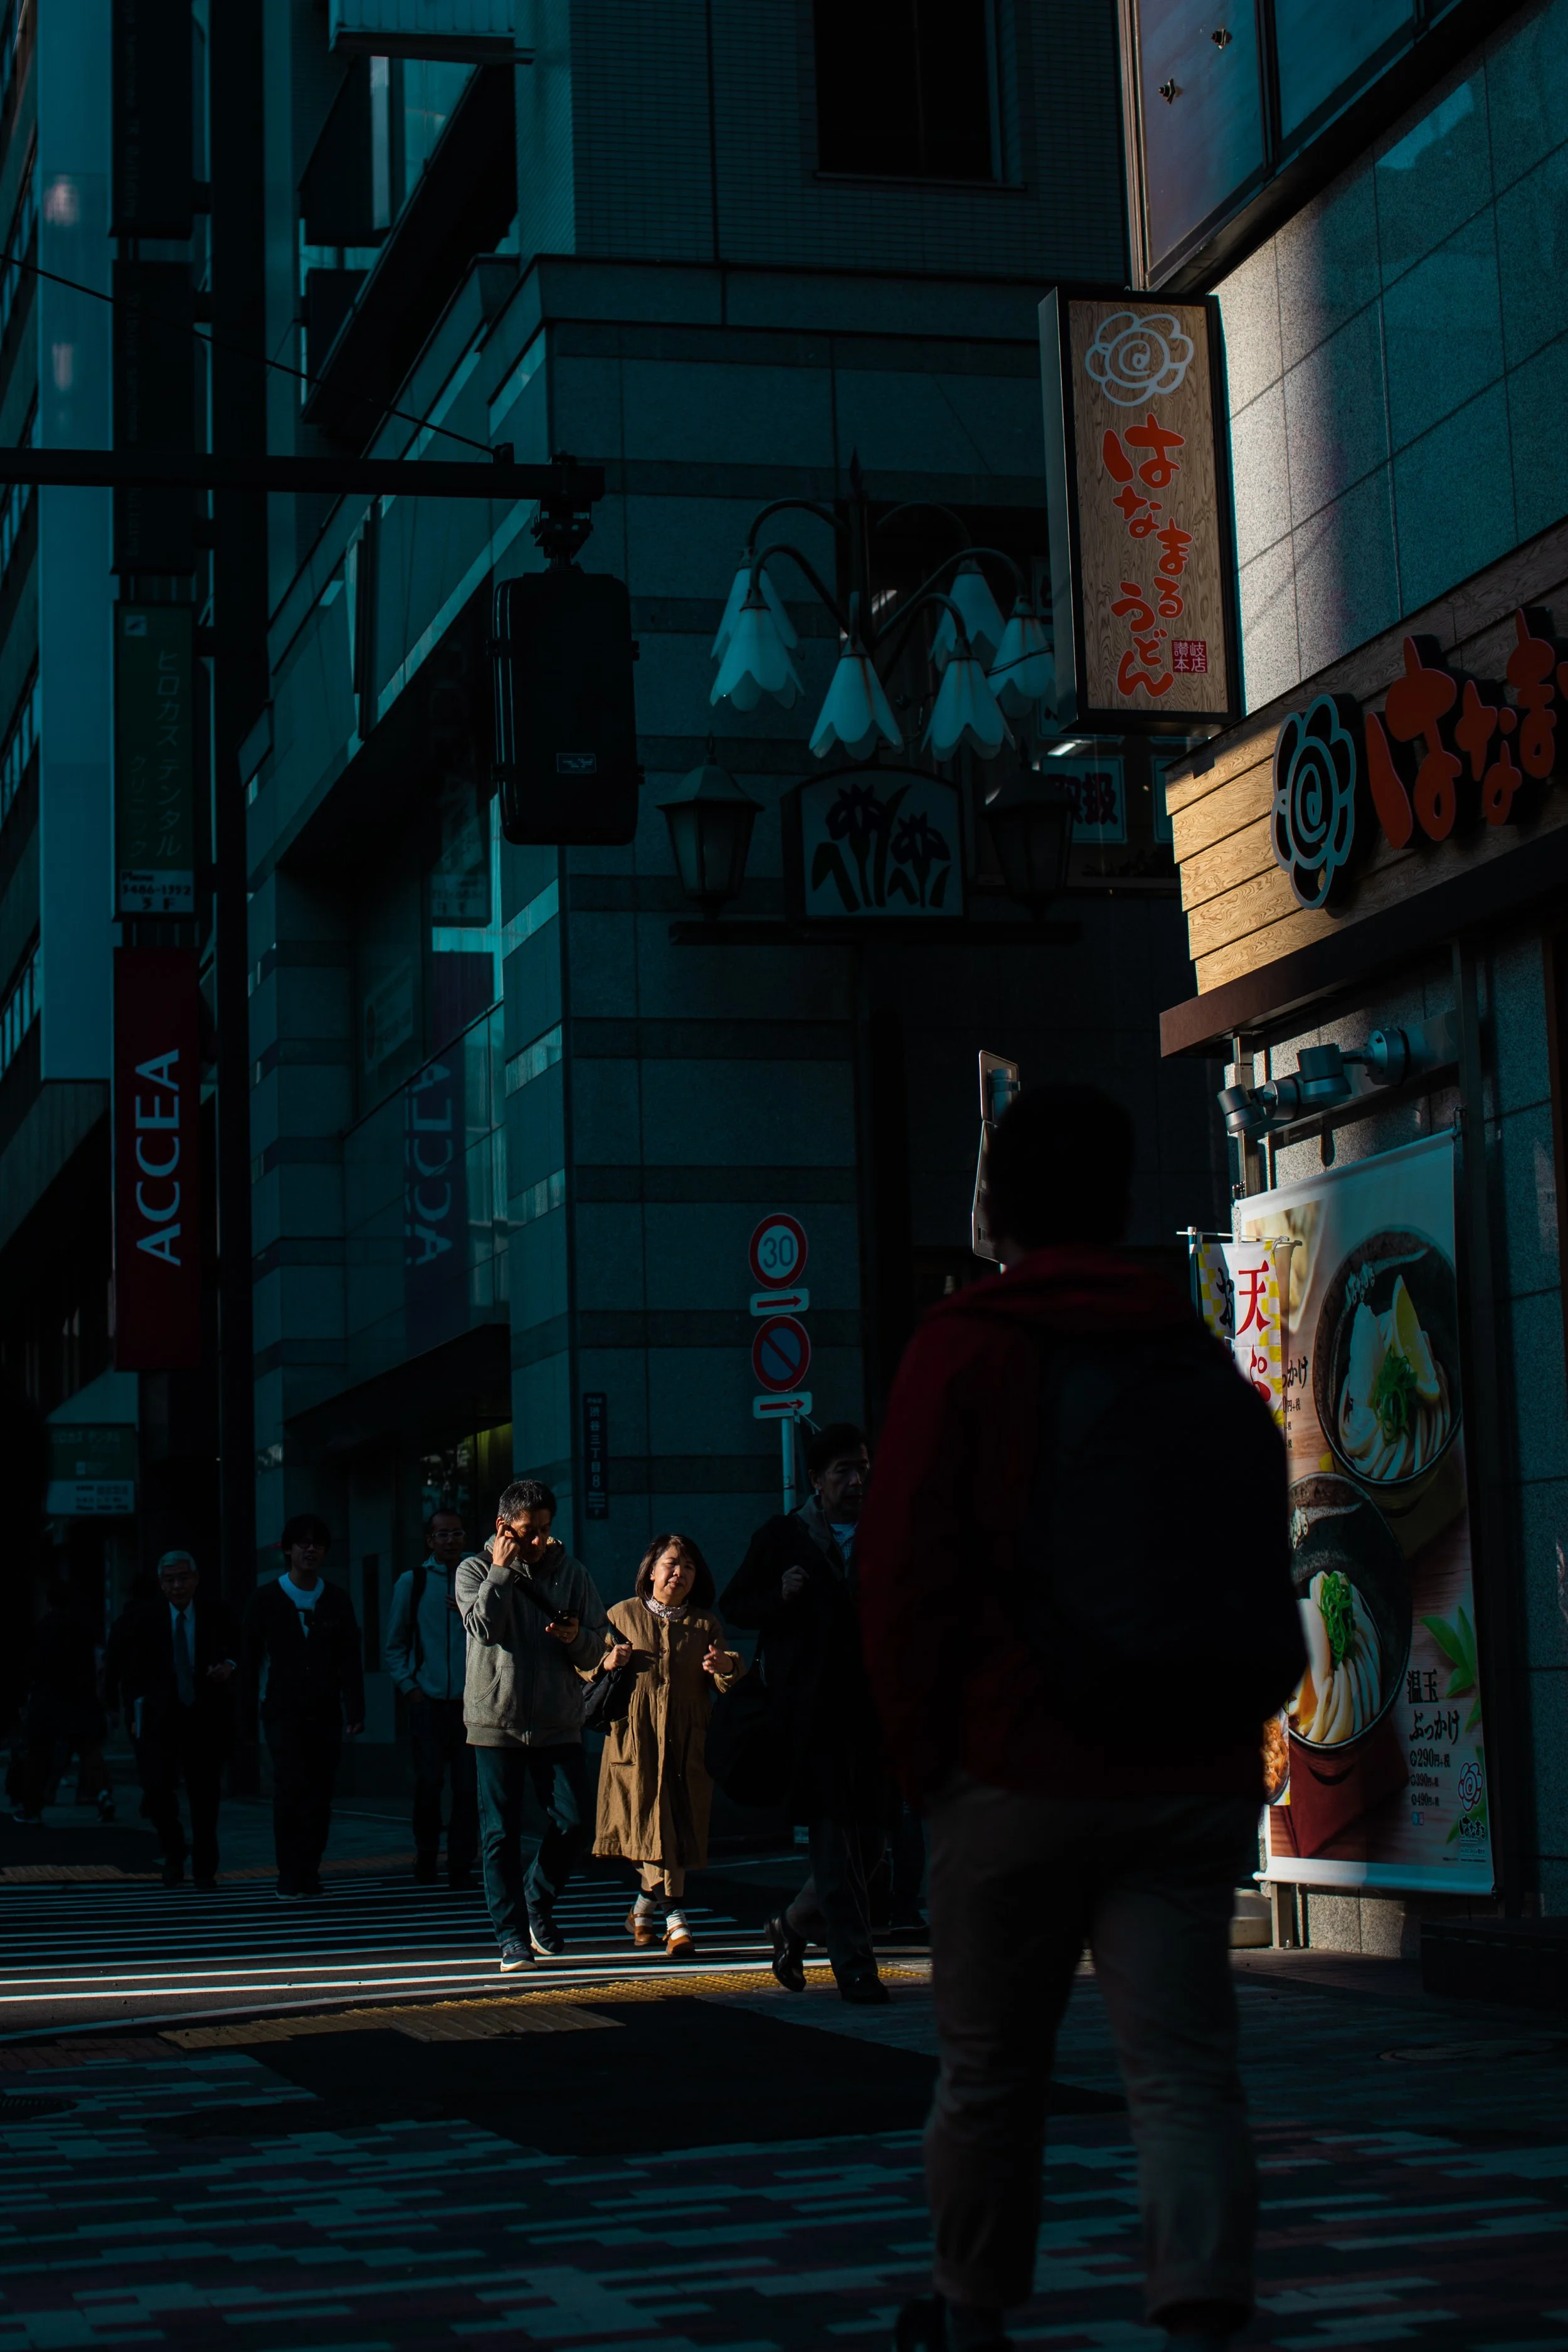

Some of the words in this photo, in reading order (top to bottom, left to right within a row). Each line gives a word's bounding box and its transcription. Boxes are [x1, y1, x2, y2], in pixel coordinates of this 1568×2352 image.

[1364, 607, 1568, 850] はなま
[134, 1048, 181, 1267] ACCEA
[763, 1234, 794, 1268] 30
[1406, 1669, 1439, 1704] 温玉
[1409, 1710, 1459, 1745] ぶっかけ
